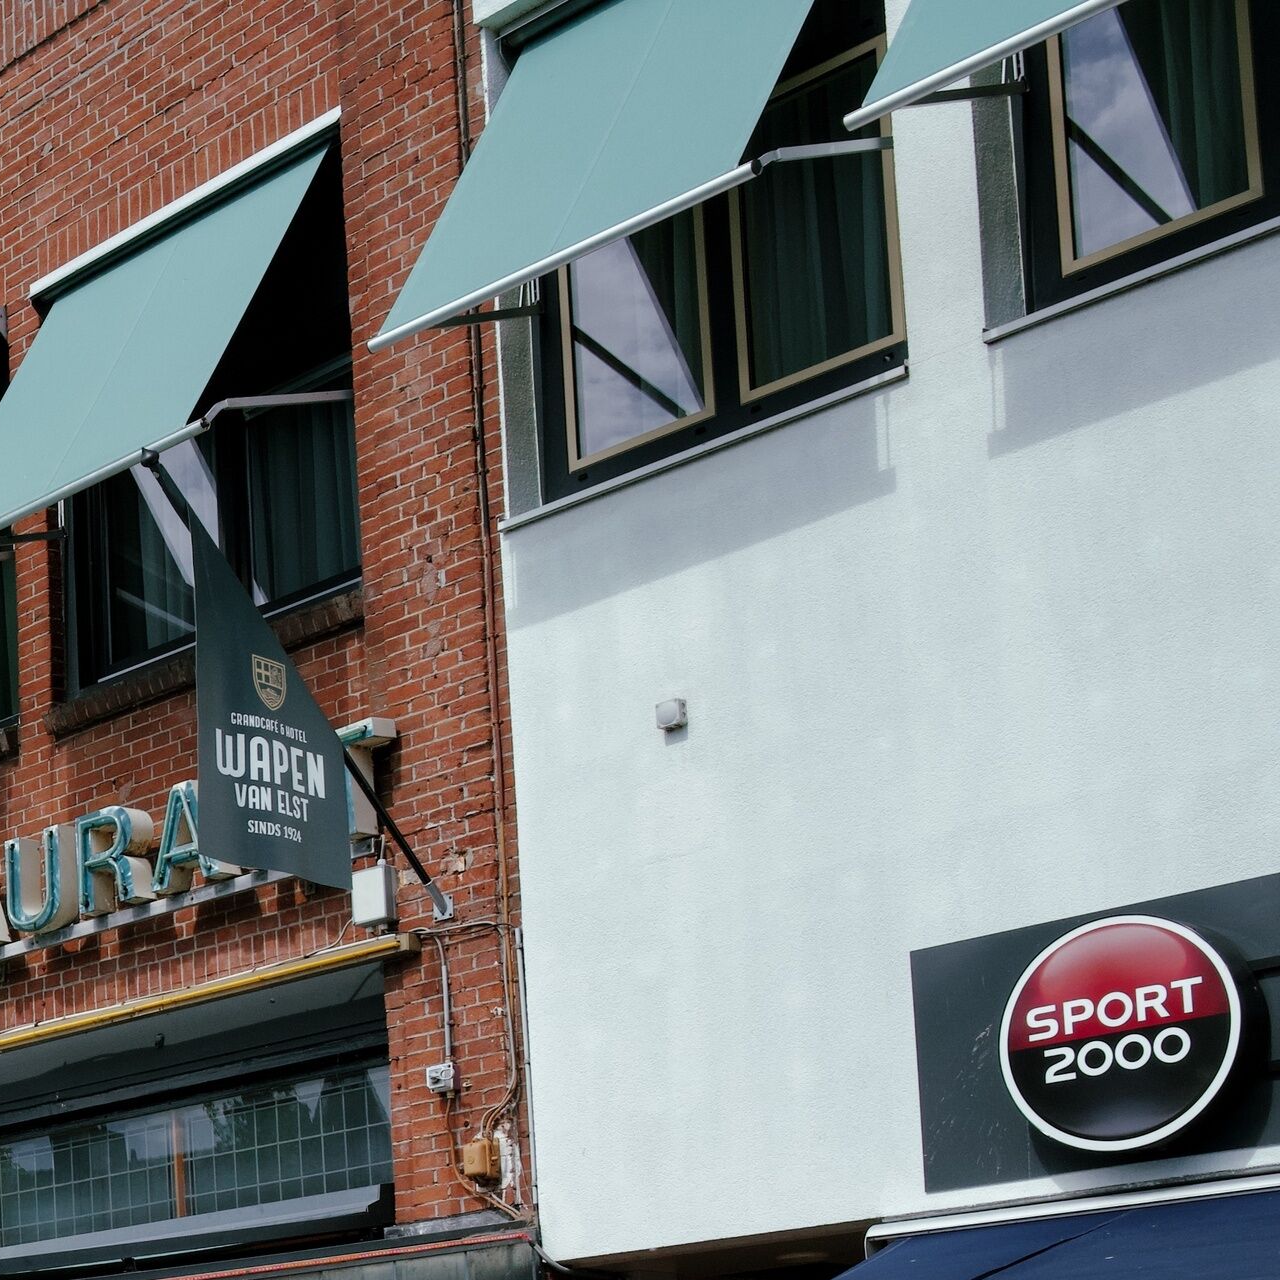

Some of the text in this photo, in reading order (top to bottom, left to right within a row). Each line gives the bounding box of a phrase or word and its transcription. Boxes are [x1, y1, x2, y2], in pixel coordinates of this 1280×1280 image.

[230, 712, 278, 734] GRANDCAFÉ
[286, 726, 308, 744] HOTEL
[215, 728, 326, 799] WAPEN
[234, 782, 309, 822] VAN ELST
[247, 820, 302, 843] SINDS 1924
[1025, 976, 1203, 1042] SPORT
[1043, 1026, 1192, 1085] 2000
